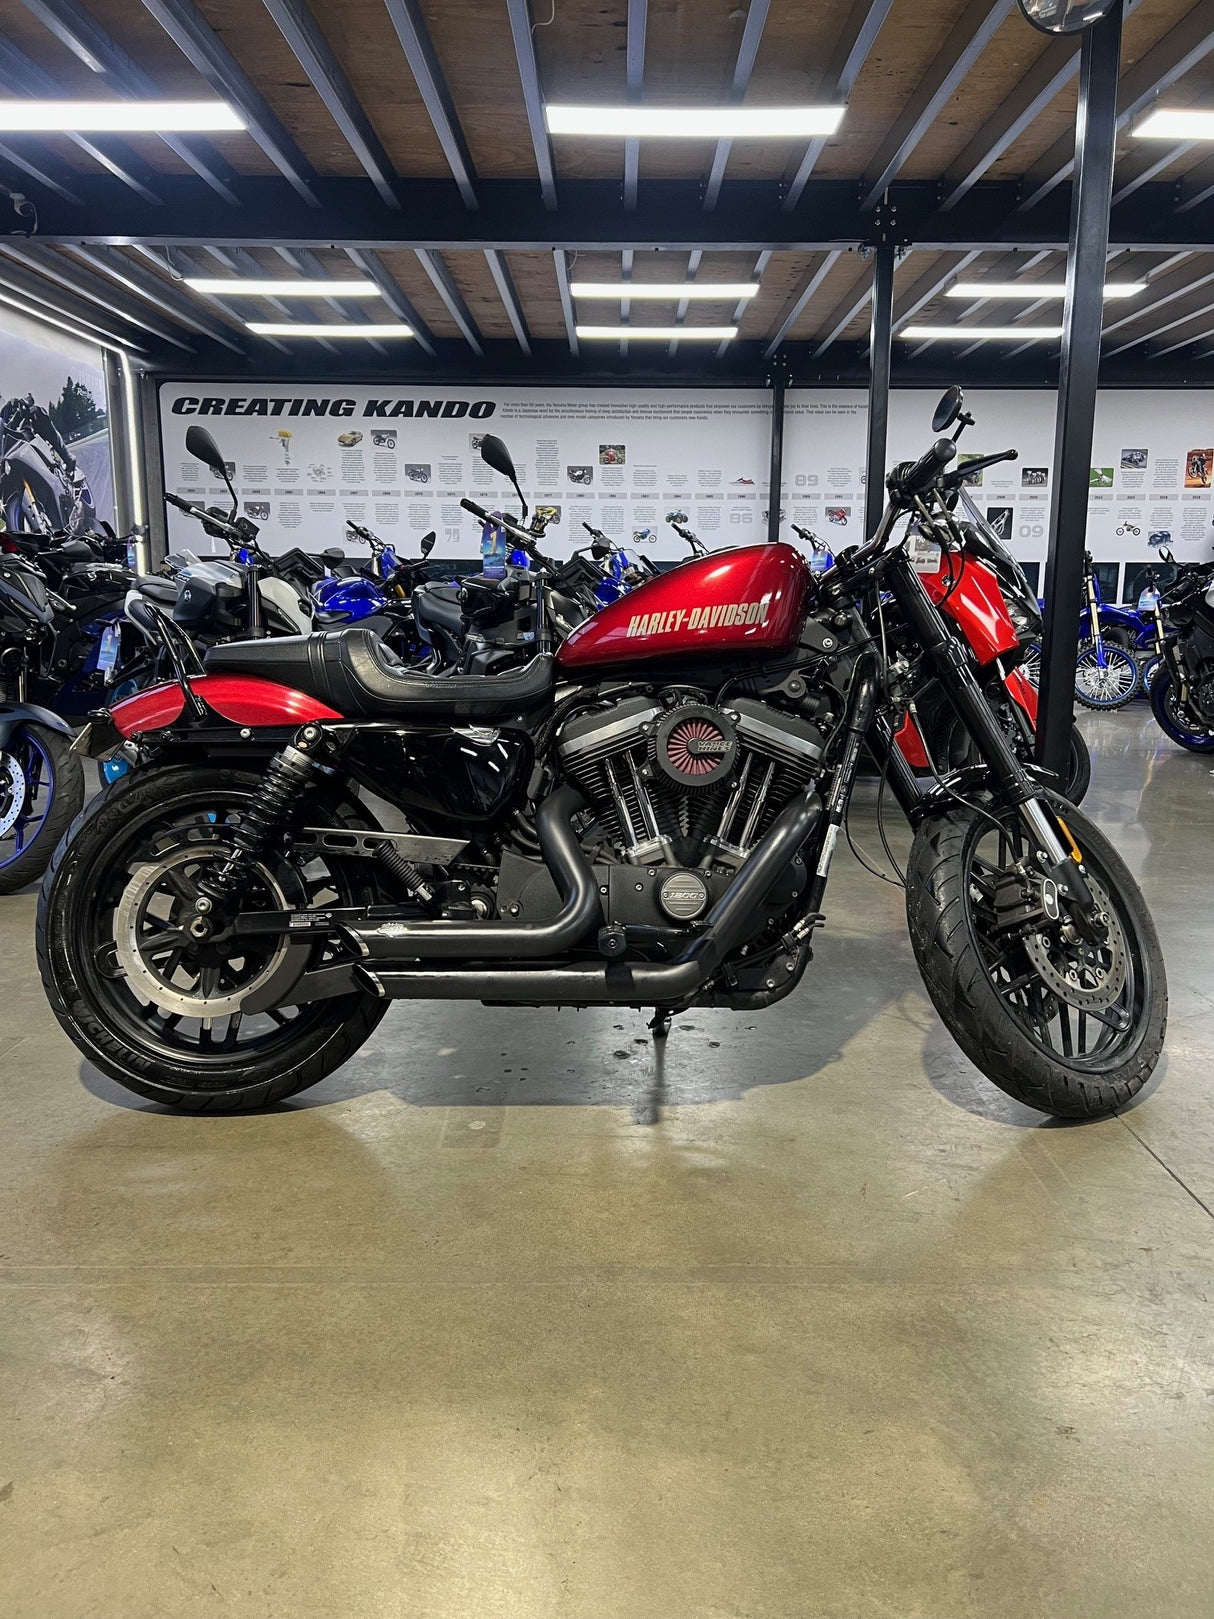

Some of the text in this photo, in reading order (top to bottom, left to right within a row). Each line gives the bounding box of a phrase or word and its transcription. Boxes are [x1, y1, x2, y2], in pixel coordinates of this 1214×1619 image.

[171, 397, 497, 419] CREATING KANDO
[1019, 525, 1044, 538] 09
[626, 602, 770, 638] HARLEY-DAVIDSON
[72, 999, 153, 1074] MICHELIN
